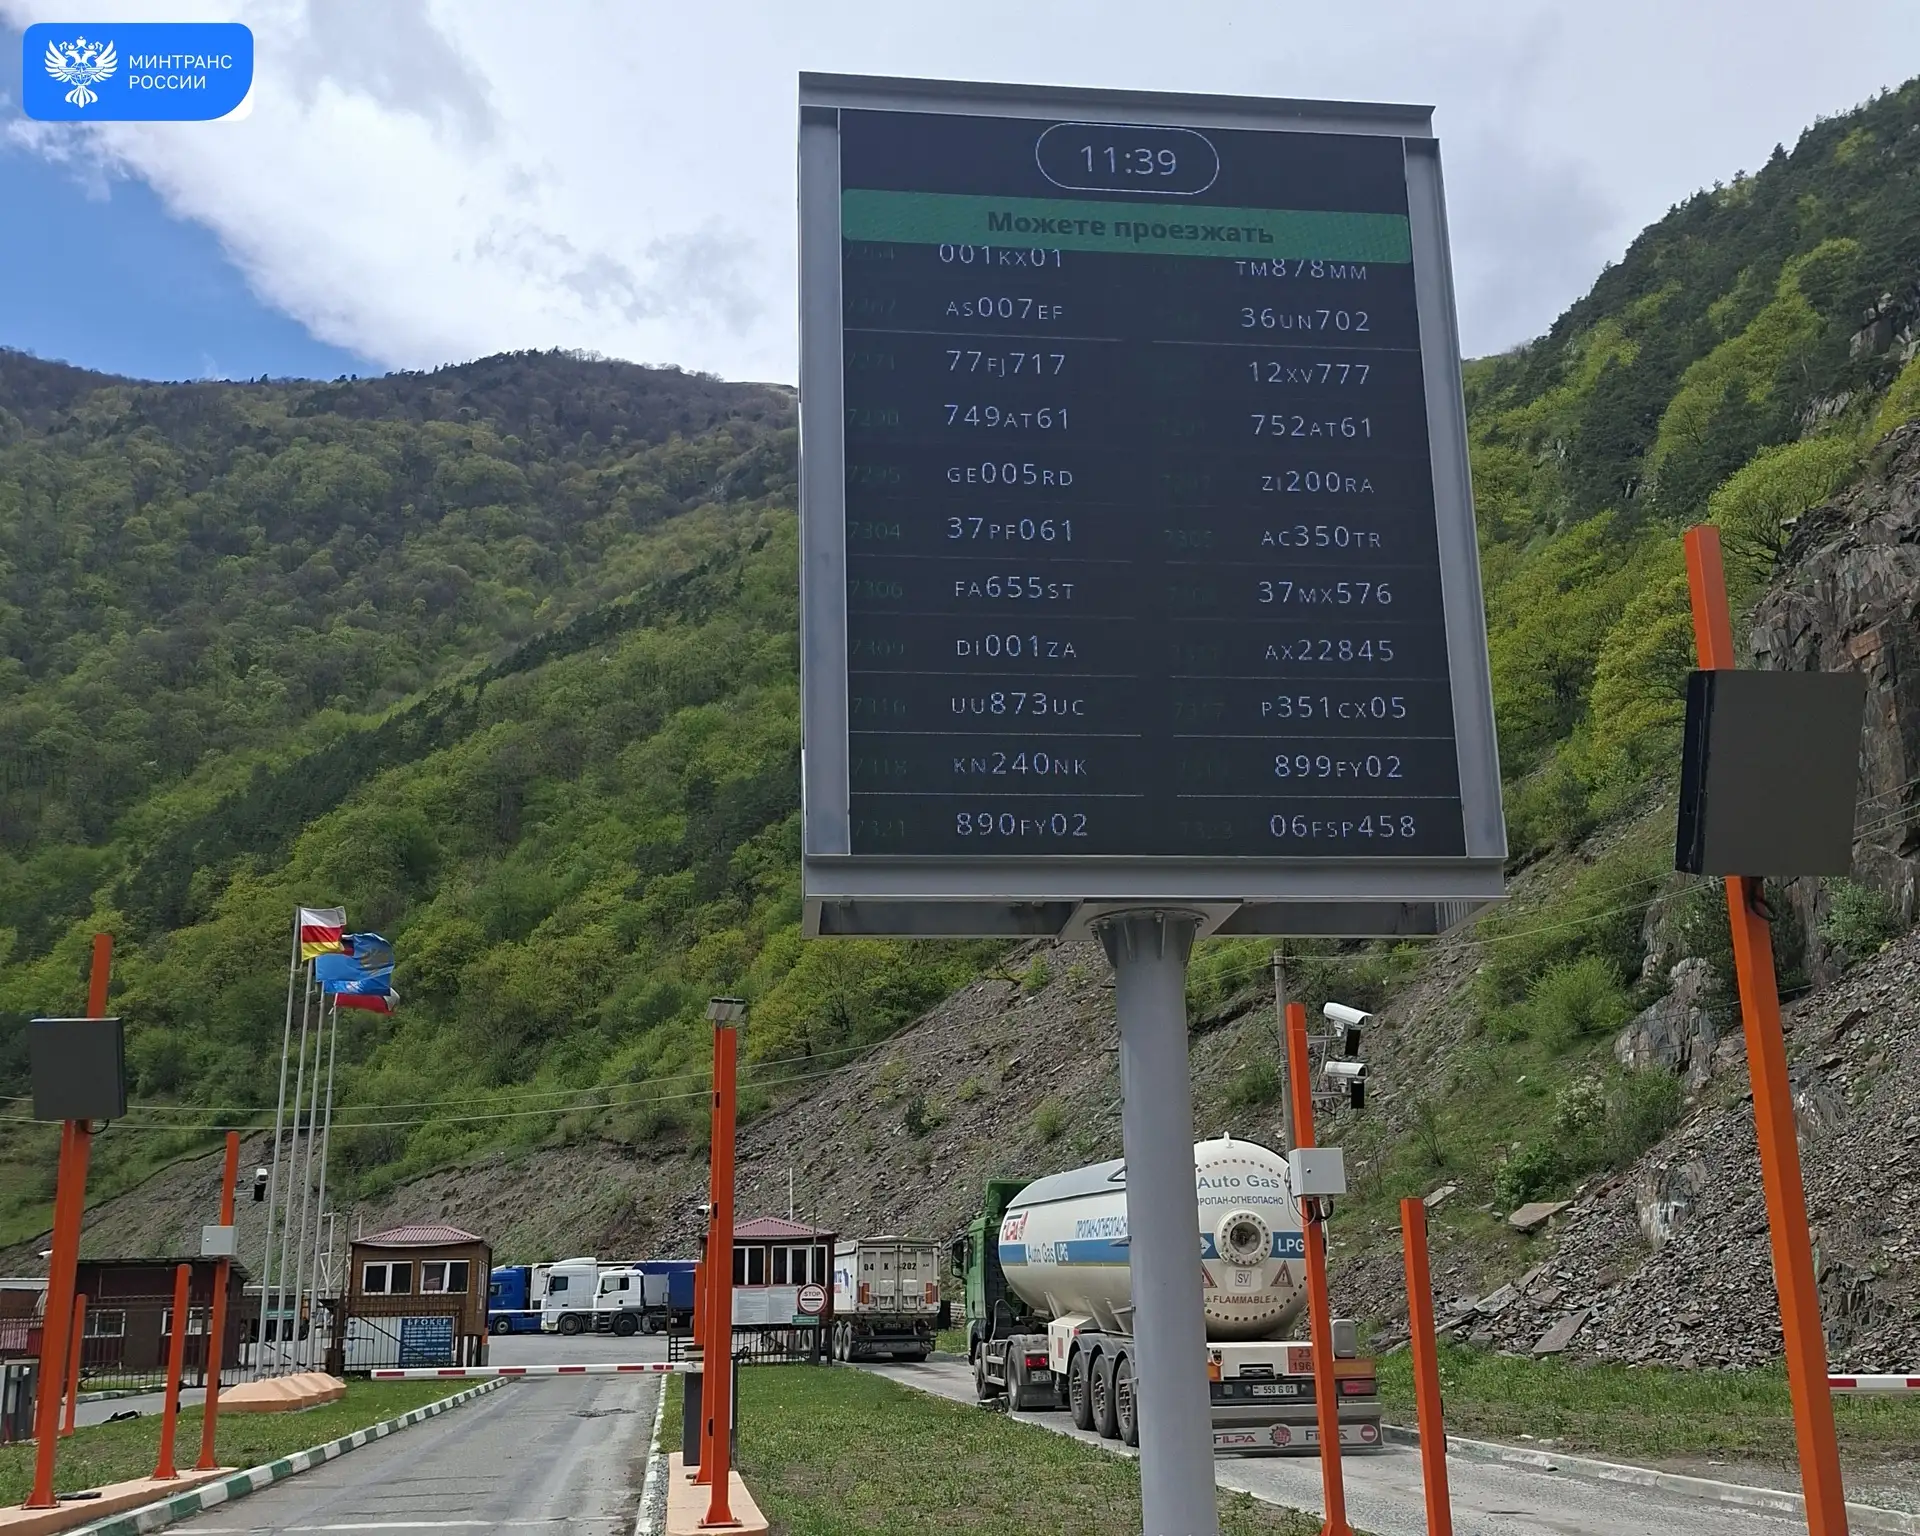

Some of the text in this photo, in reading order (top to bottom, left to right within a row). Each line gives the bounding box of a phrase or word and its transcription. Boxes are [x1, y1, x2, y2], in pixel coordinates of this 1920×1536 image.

[1080, 145, 1177, 176] 11:39
[988, 210, 1275, 245] Можете проезжать
[946, 296, 1064, 320] AS007EF
[1241, 307, 1370, 332] 36UN702
[946, 350, 1065, 378] 77FJ717
[1249, 361, 1370, 385] 12XV777
[943, 404, 1067, 430] 749AT61
[1251, 414, 1371, 438] 752AT61
[947, 462, 1073, 486] GE005RD
[1261, 470, 1375, 494] ZI200RA
[947, 516, 1072, 542] 37PF061
[1262, 525, 1381, 548] AC350TR
[955, 575, 1075, 599] FA655ST
[1258, 581, 1392, 605] 37MX576
[956, 634, 1077, 658] DI001ZA
[1265, 639, 1394, 662] AX22845
[951, 691, 1084, 716] UU873UC
[1261, 695, 1406, 719] P351CX05
[954, 751, 1087, 775] KN240NK
[1274, 754, 1403, 778] 899FY02
[956, 812, 1088, 837] 890FY02
[1270, 814, 1416, 838] 06FSP458
[1197, 1174, 1280, 1189] Auto Gas
[1199, 1196, 1284, 1205] РОПАН-ОГНЕОПАСНО
[1042, 1243, 1055, 1263] Gas
[1056, 1243, 1069, 1261] LPG
[1278, 1238, 1304, 1252] LPG
[863, 1263, 874, 1271] 04
[902, 1262, 917, 1270] 202
[1237, 1274, 1249, 1284] SV
[1213, 1295, 1272, 1304] FLAMMABLE
[407, 1318, 449, 1326] БРОКЕР
[1213, 1431, 1257, 1445] FILPA
[1305, 1429, 1349, 1441] FIA
